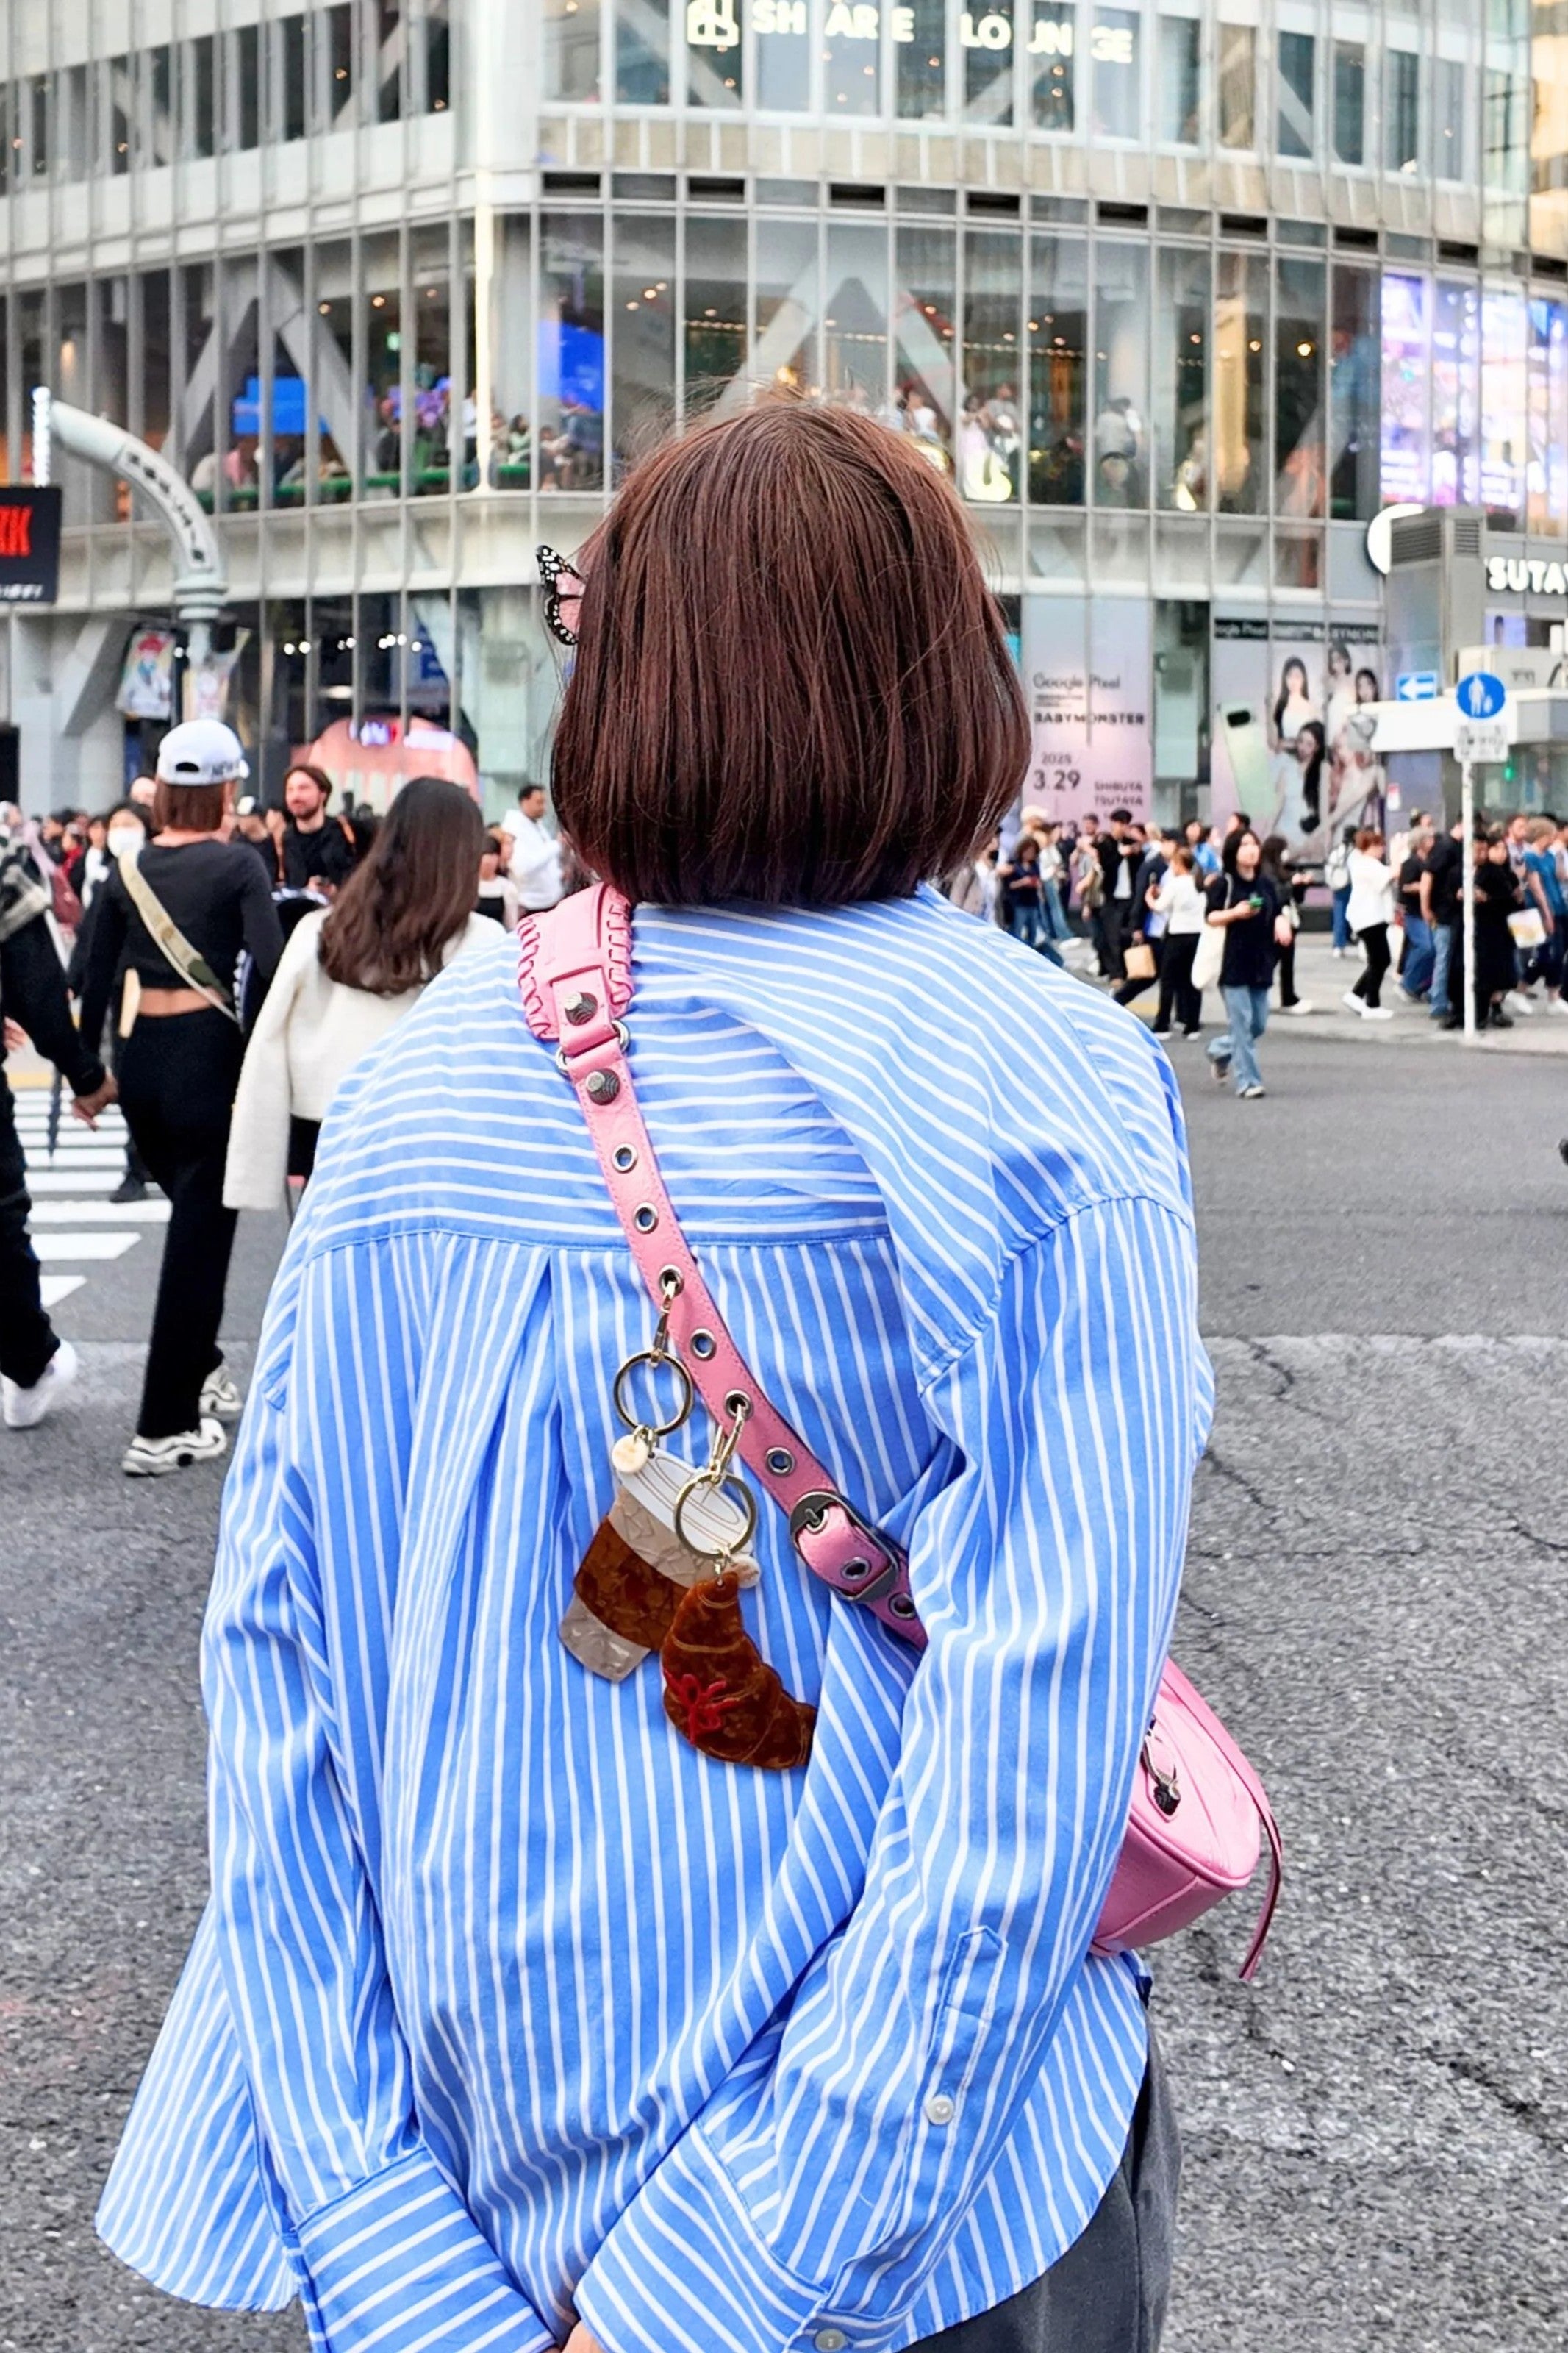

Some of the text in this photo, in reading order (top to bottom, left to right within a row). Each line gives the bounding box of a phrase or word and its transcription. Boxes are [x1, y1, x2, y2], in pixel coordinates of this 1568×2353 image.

[751, 0, 915, 43] SHARE
[1483, 557, 1568, 595] SUTA
[1033, 672, 1121, 691] Google Pixel
[1033, 769, 1081, 790] 3.29
[1094, 781, 1144, 793] SHIBUYA
[1094, 795, 1144, 807] TSUTAYA
